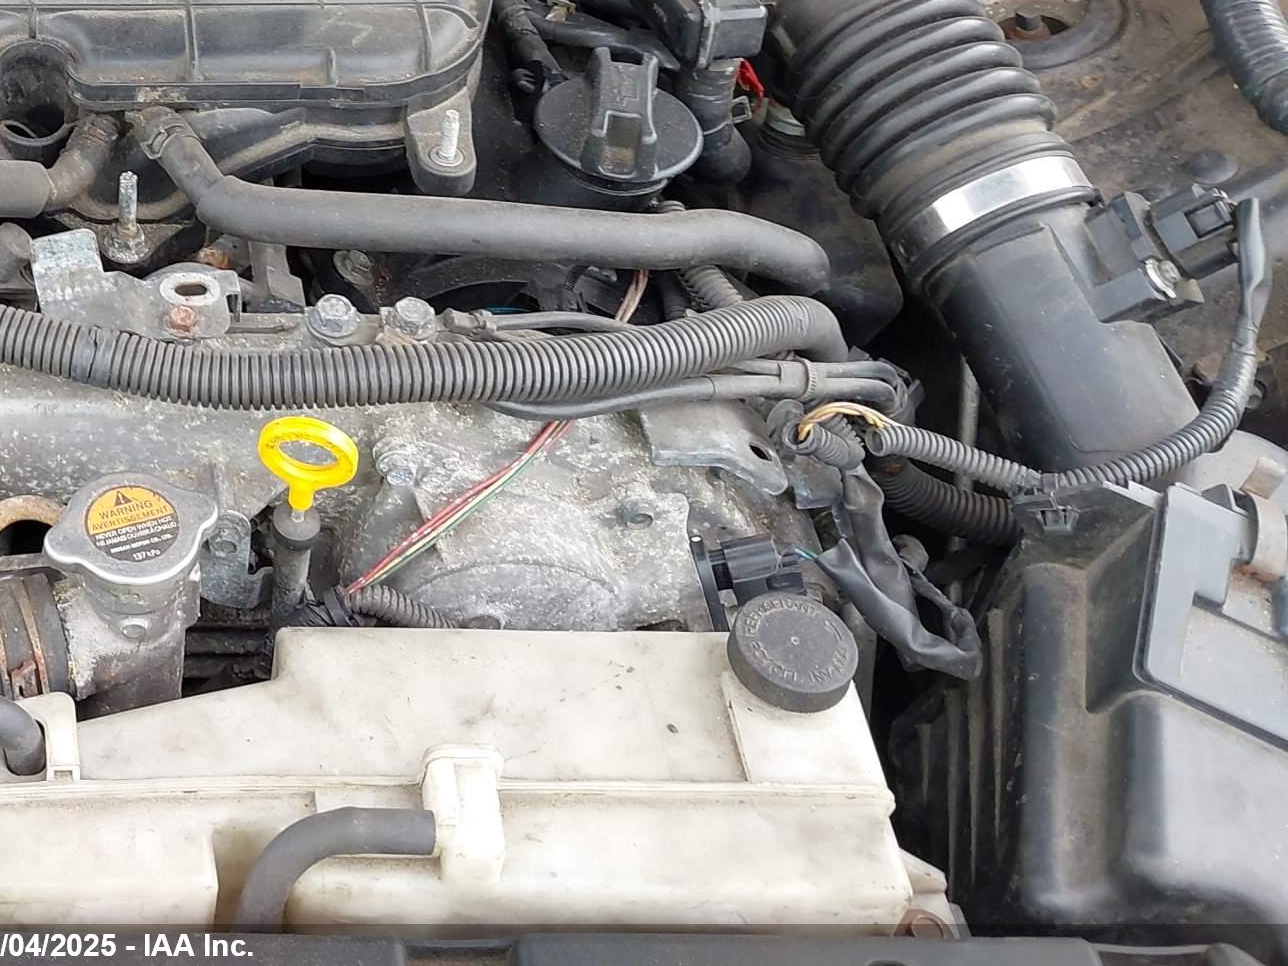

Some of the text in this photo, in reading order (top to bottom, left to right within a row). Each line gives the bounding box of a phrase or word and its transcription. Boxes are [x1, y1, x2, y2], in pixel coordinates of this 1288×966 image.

[92, 506, 168, 531] AVERTISSEMENT
[99, 500, 153, 519] WARNING
[95, 516, 172, 540] NEVER OPEN WHEN HOT
[132, 551, 146, 561] 137
